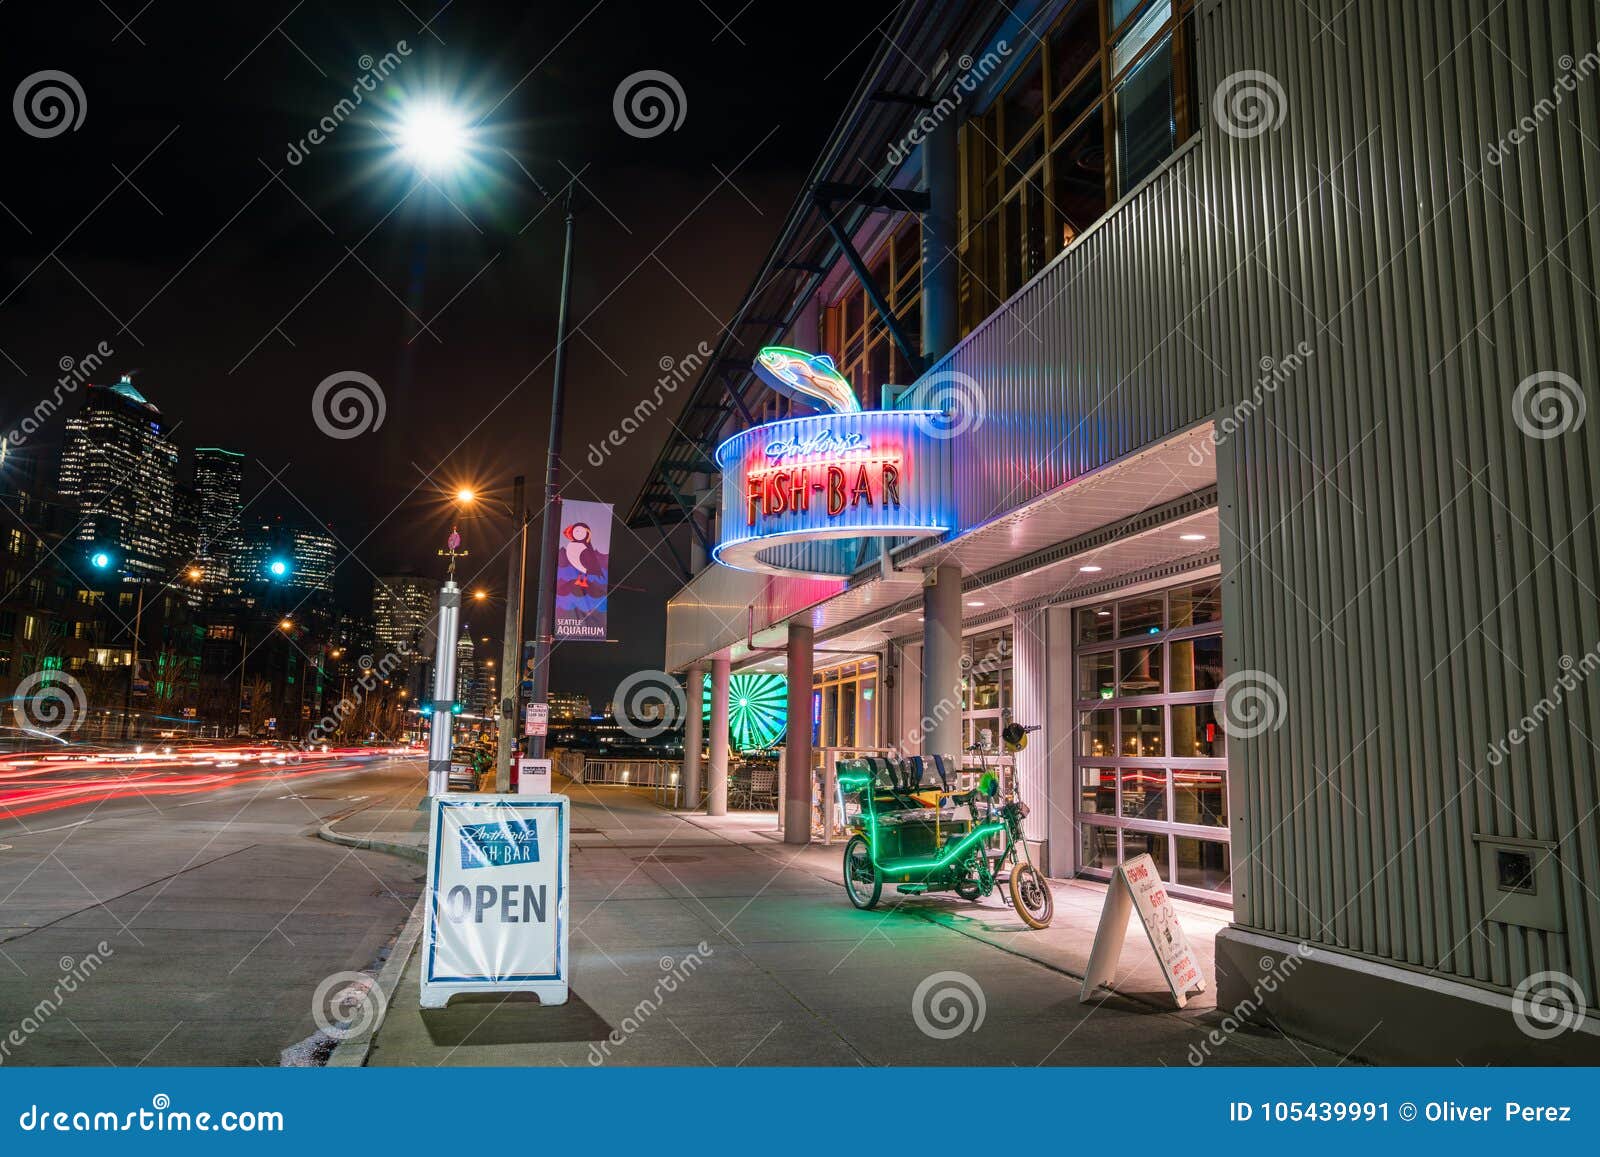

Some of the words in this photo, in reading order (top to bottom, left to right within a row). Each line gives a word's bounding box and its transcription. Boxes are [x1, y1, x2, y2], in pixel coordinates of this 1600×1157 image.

[557, 618, 583, 626] SEATTLE
[556, 625, 604, 636] AQUARIUM
[504, 845, 530, 864] BAR
[447, 884, 547, 924] OPEN
